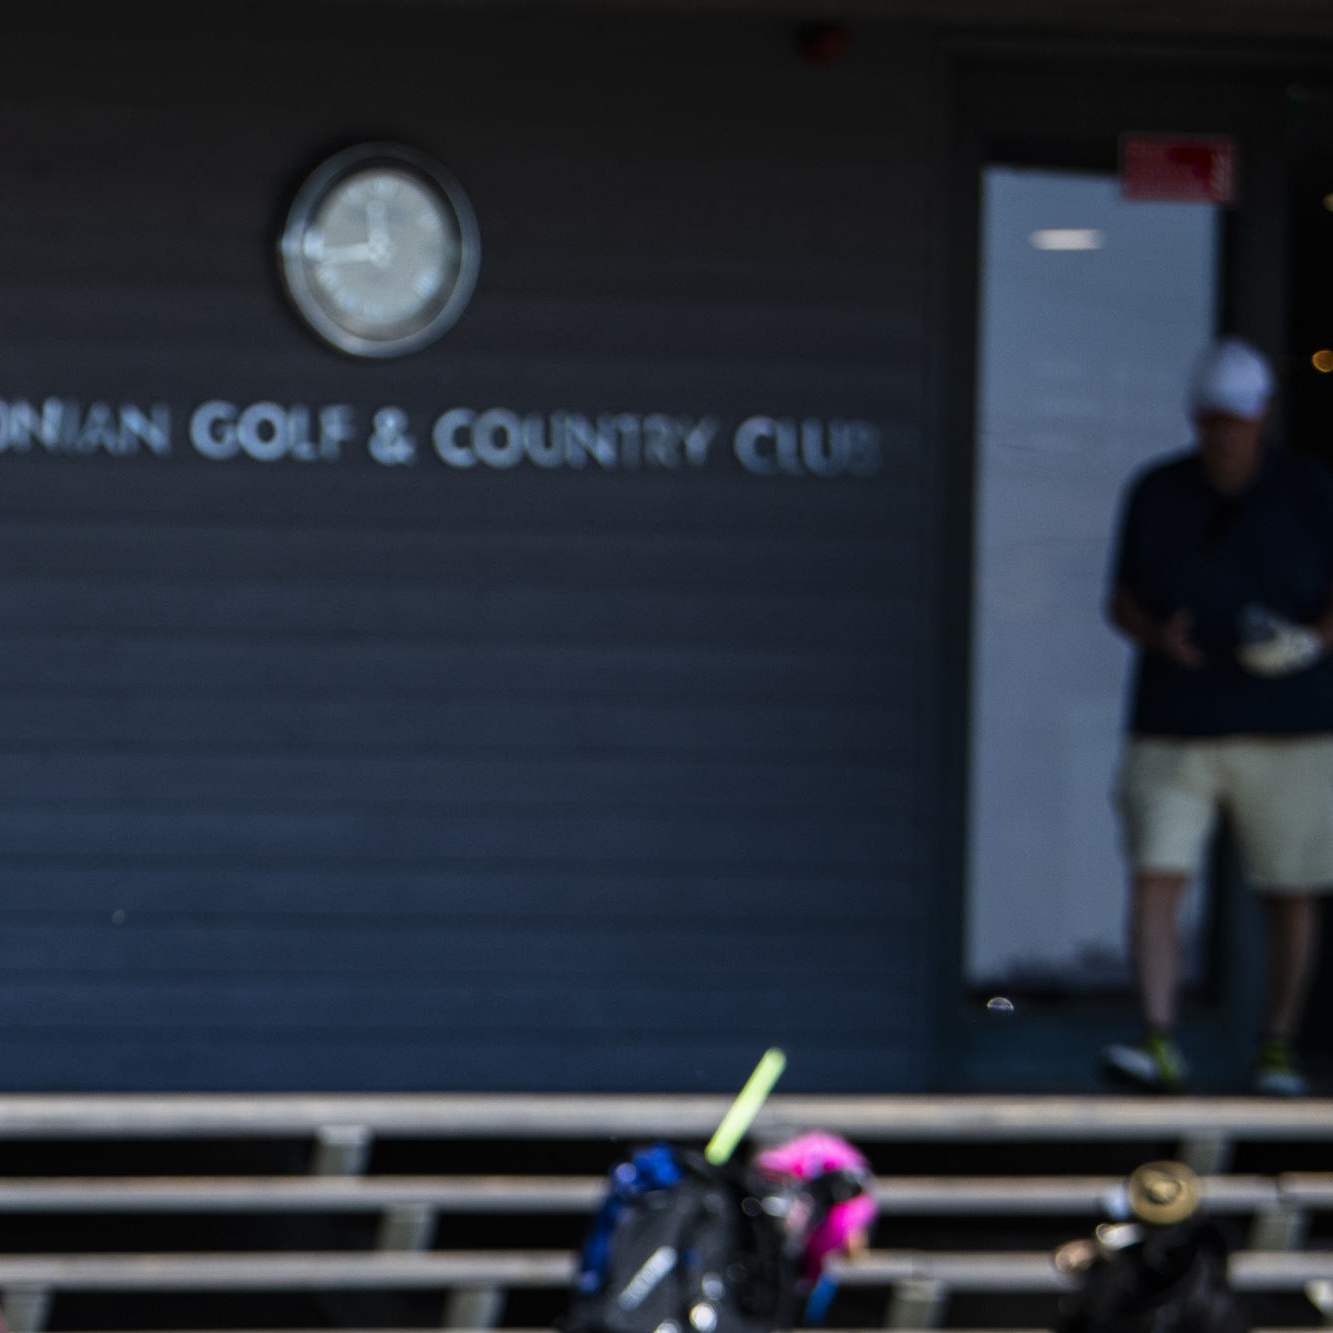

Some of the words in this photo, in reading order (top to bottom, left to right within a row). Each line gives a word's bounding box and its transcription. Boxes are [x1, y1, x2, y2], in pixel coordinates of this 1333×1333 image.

[189, 399, 351, 461] GOLF
[367, 405, 418, 467] &
[432, 408, 718, 471] COUNTRY
[733, 416, 884, 476] CLUB
